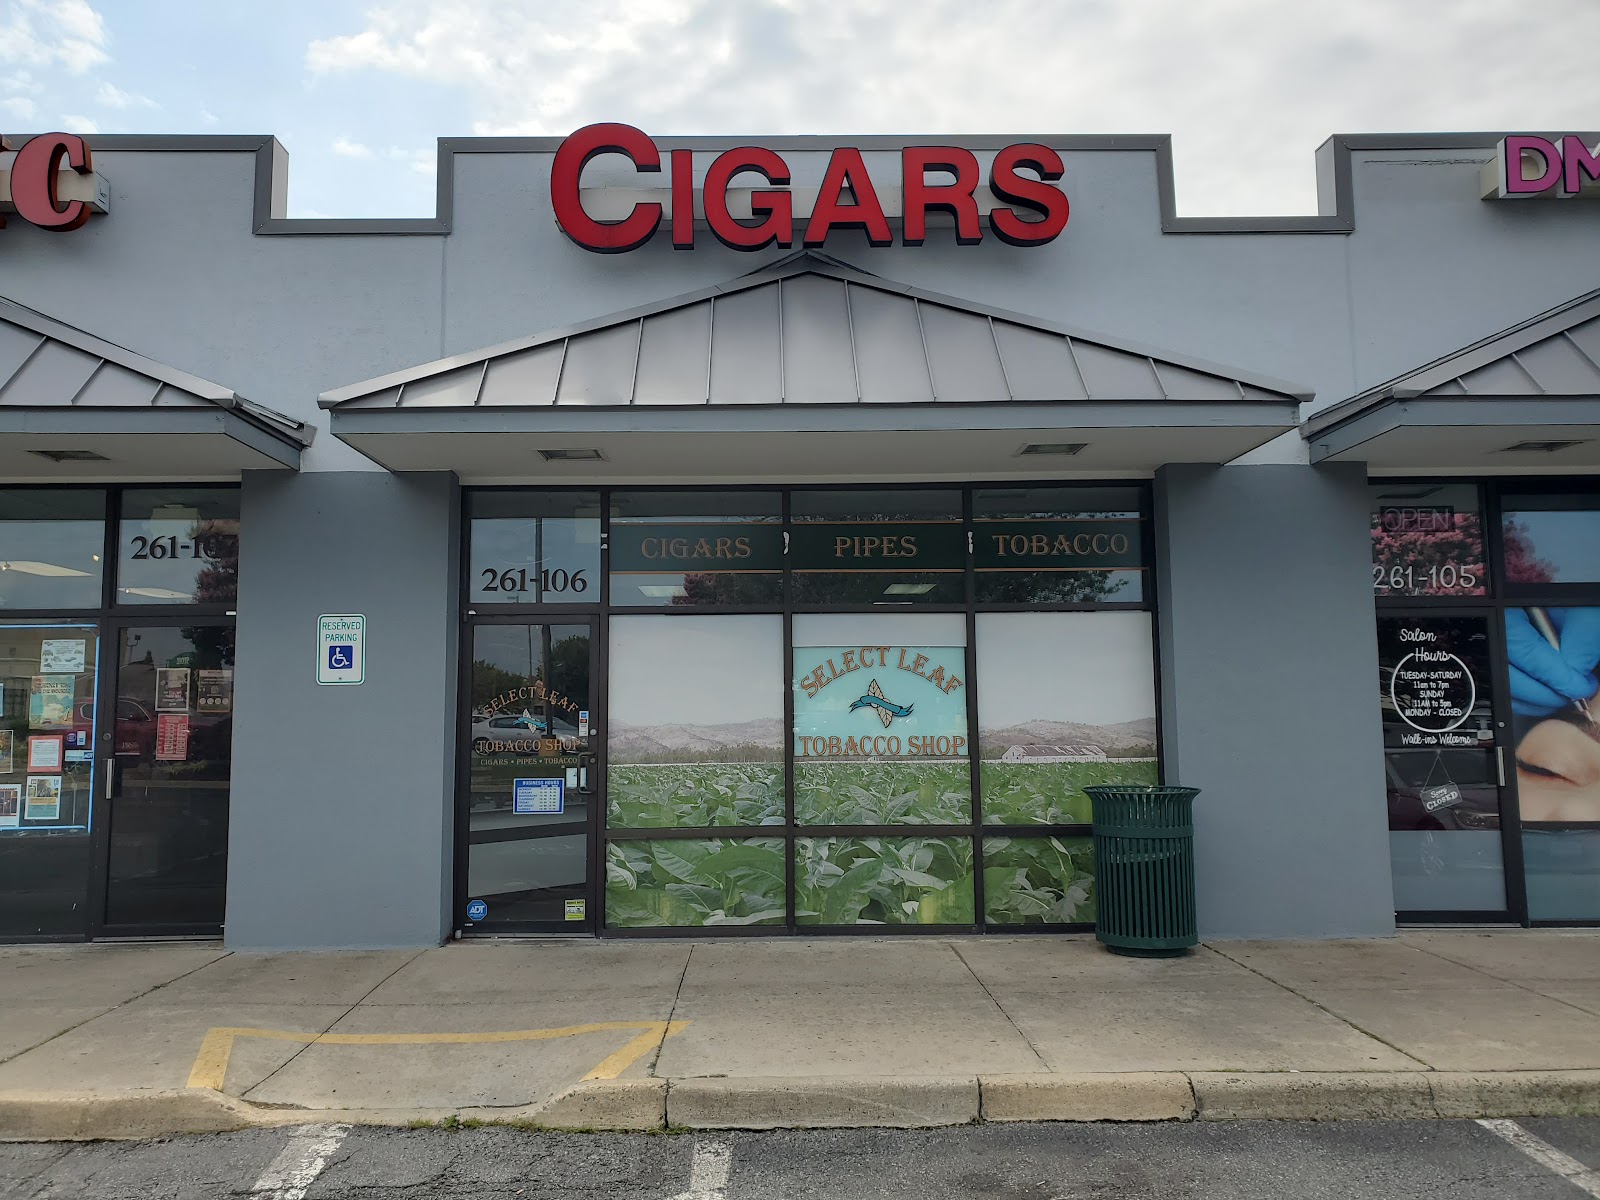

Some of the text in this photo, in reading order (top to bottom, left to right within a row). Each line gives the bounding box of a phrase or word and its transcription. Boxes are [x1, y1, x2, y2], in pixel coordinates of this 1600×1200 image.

[551, 122, 1070, 254] CIGARS
[1384, 507, 1449, 531] OPEN
[641, 533, 1129, 560] CIGARS PIPES TOBACCO
[481, 568, 588, 592] 261-106
[1372, 564, 1476, 589] 261-105
[322, 621, 361, 630] RESERVED
[325, 633, 358, 641] PARKING
[1400, 627, 1437, 642] Salon
[1414, 646, 1451, 662] Hours
[800, 646, 963, 699] SELECT LEAF
[1400, 671, 1462, 679] TUESDAY-SATURDAY
[482, 686, 579, 717] SELECT LEAF
[1419, 690, 1445, 698] SUNDAY
[1405, 709, 1431, 717] MONDAY
[1438, 708, 1462, 716] CLOSED
[479, 738, 581, 752] TOBACCO SHOP
[798, 735, 966, 756] TOBACCO SHOP
[480, 758, 508, 766] CIGARS
[544, 757, 577, 765] TOBACCO
[469, 905, 485, 914] ADT
